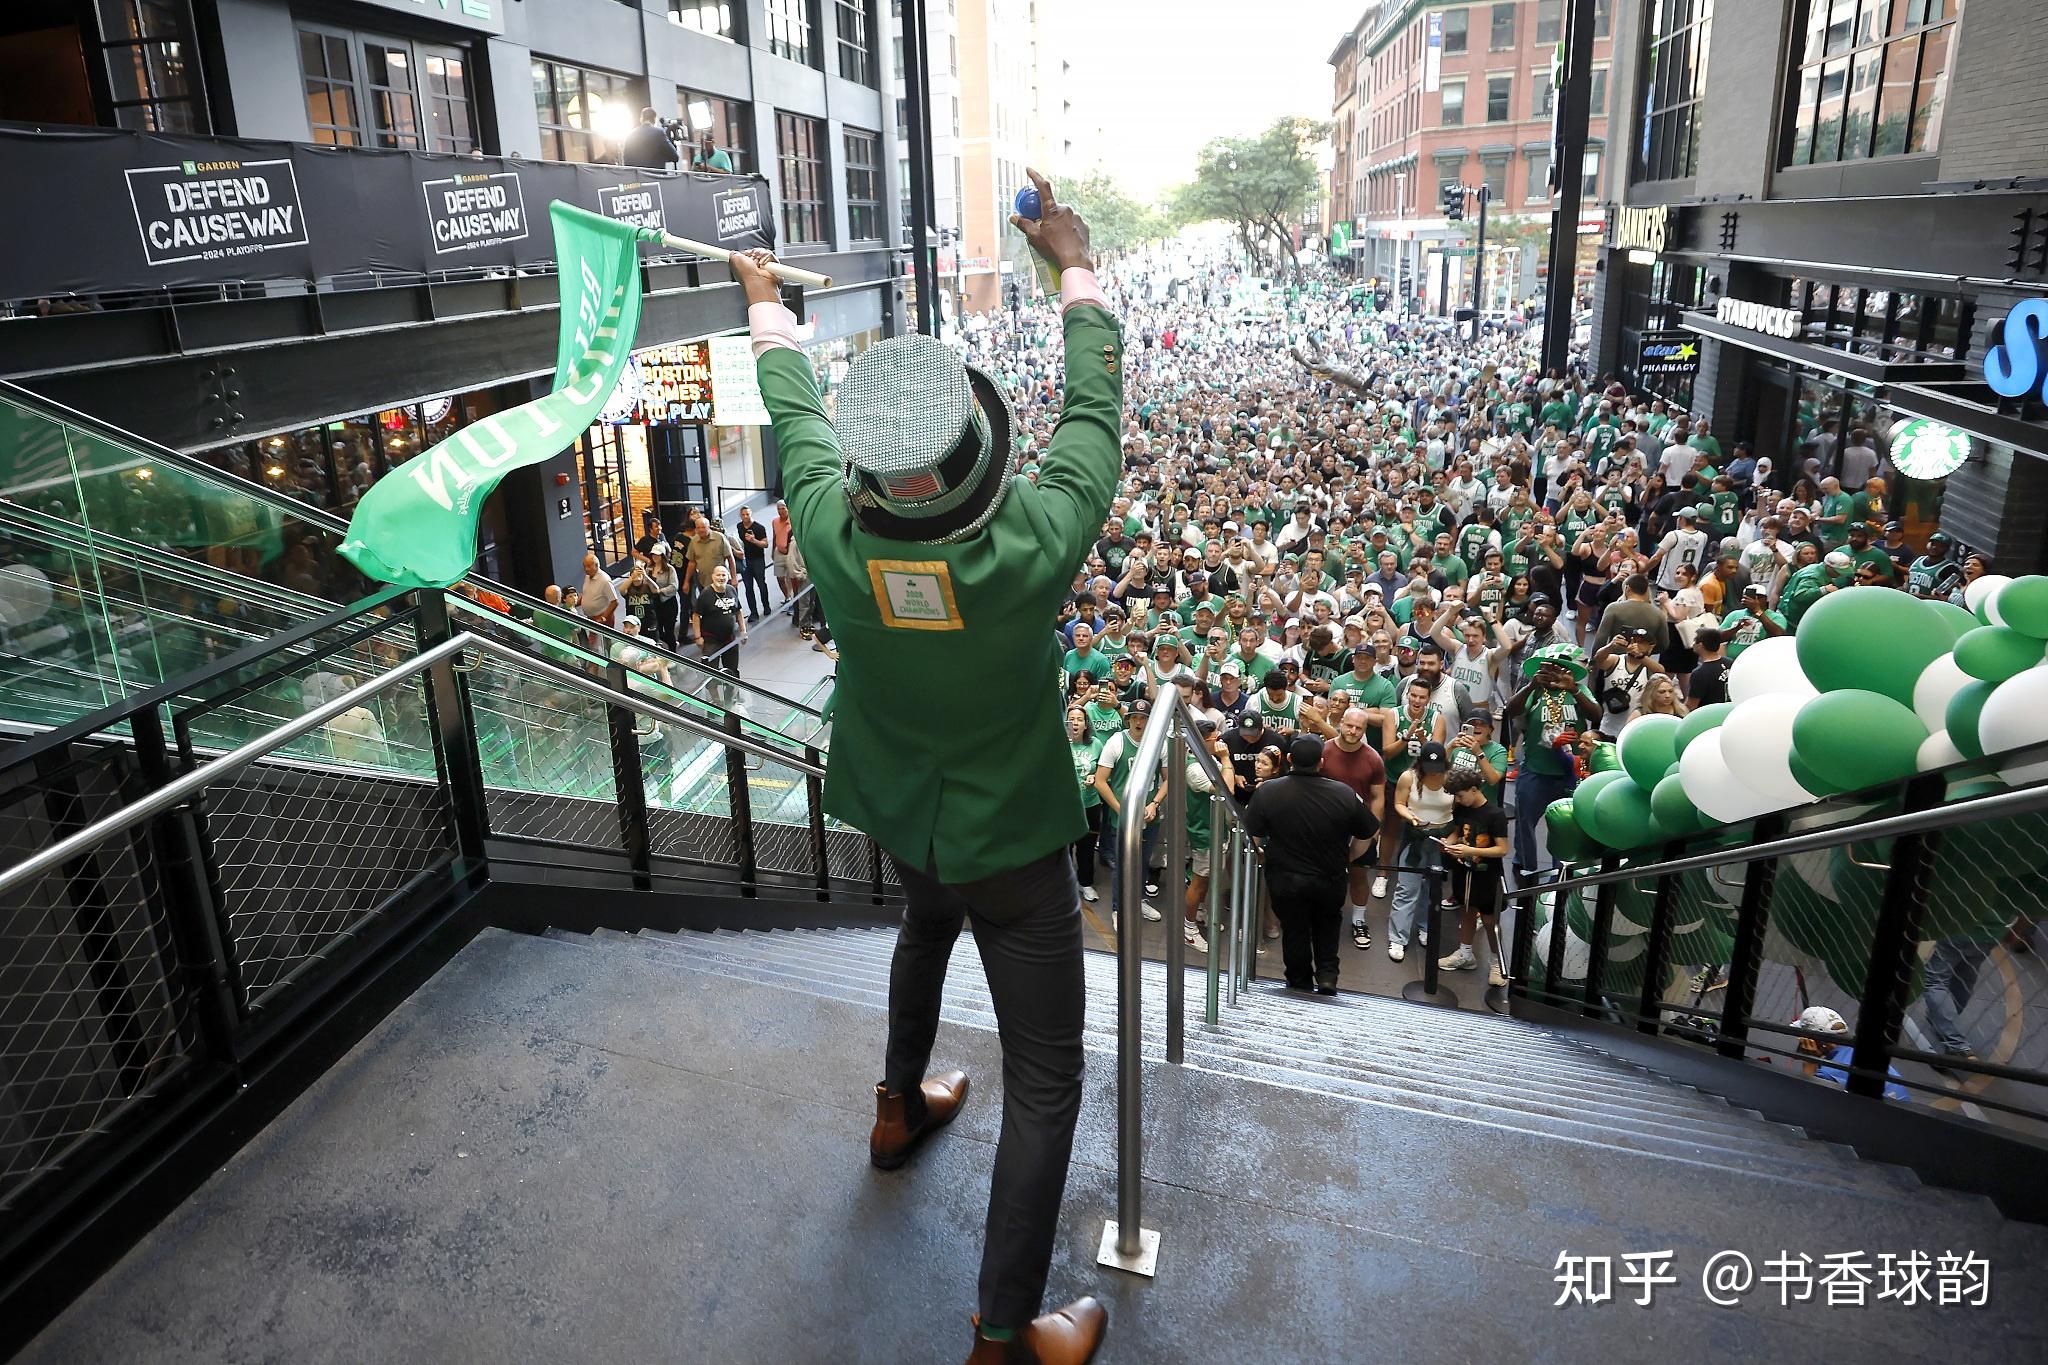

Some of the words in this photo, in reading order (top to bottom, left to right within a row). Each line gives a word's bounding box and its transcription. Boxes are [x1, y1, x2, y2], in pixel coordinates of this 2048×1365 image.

[197, 160, 240, 172] GARDEN
[164, 176, 270, 213] DEFEND
[444, 185, 506, 214] DEFEND
[612, 192, 652, 215] DEFEND
[722, 196, 751, 215] DEFEND
[148, 205, 293, 250] CAUSEWAY
[436, 207, 519, 242] CAUSEWAY
[719, 211, 758, 233] CAUSEWAY
[1617, 204, 1667, 254] BANNERS
[203, 250, 224, 260] 2024
[227, 244, 264, 256] PLAYOFFS
[1716, 297, 1798, 338] STARBUCKS
[641, 345, 699, 364] WHERE
[643, 365, 709, 383] BOSTON
[1642, 363, 1697, 373] PHARMACY
[669, 402, 711, 420] PLAY
[1601, 437, 1611, 450] 7
[1721, 508, 1734, 525] 0
[1468, 543, 1480, 560] 9
[1682, 549, 1696, 563] 0
[900, 606, 940, 616] CHAMPIONS
[905, 599, 930, 608] WORLD
[1454, 666, 1482, 685] CELTICS
